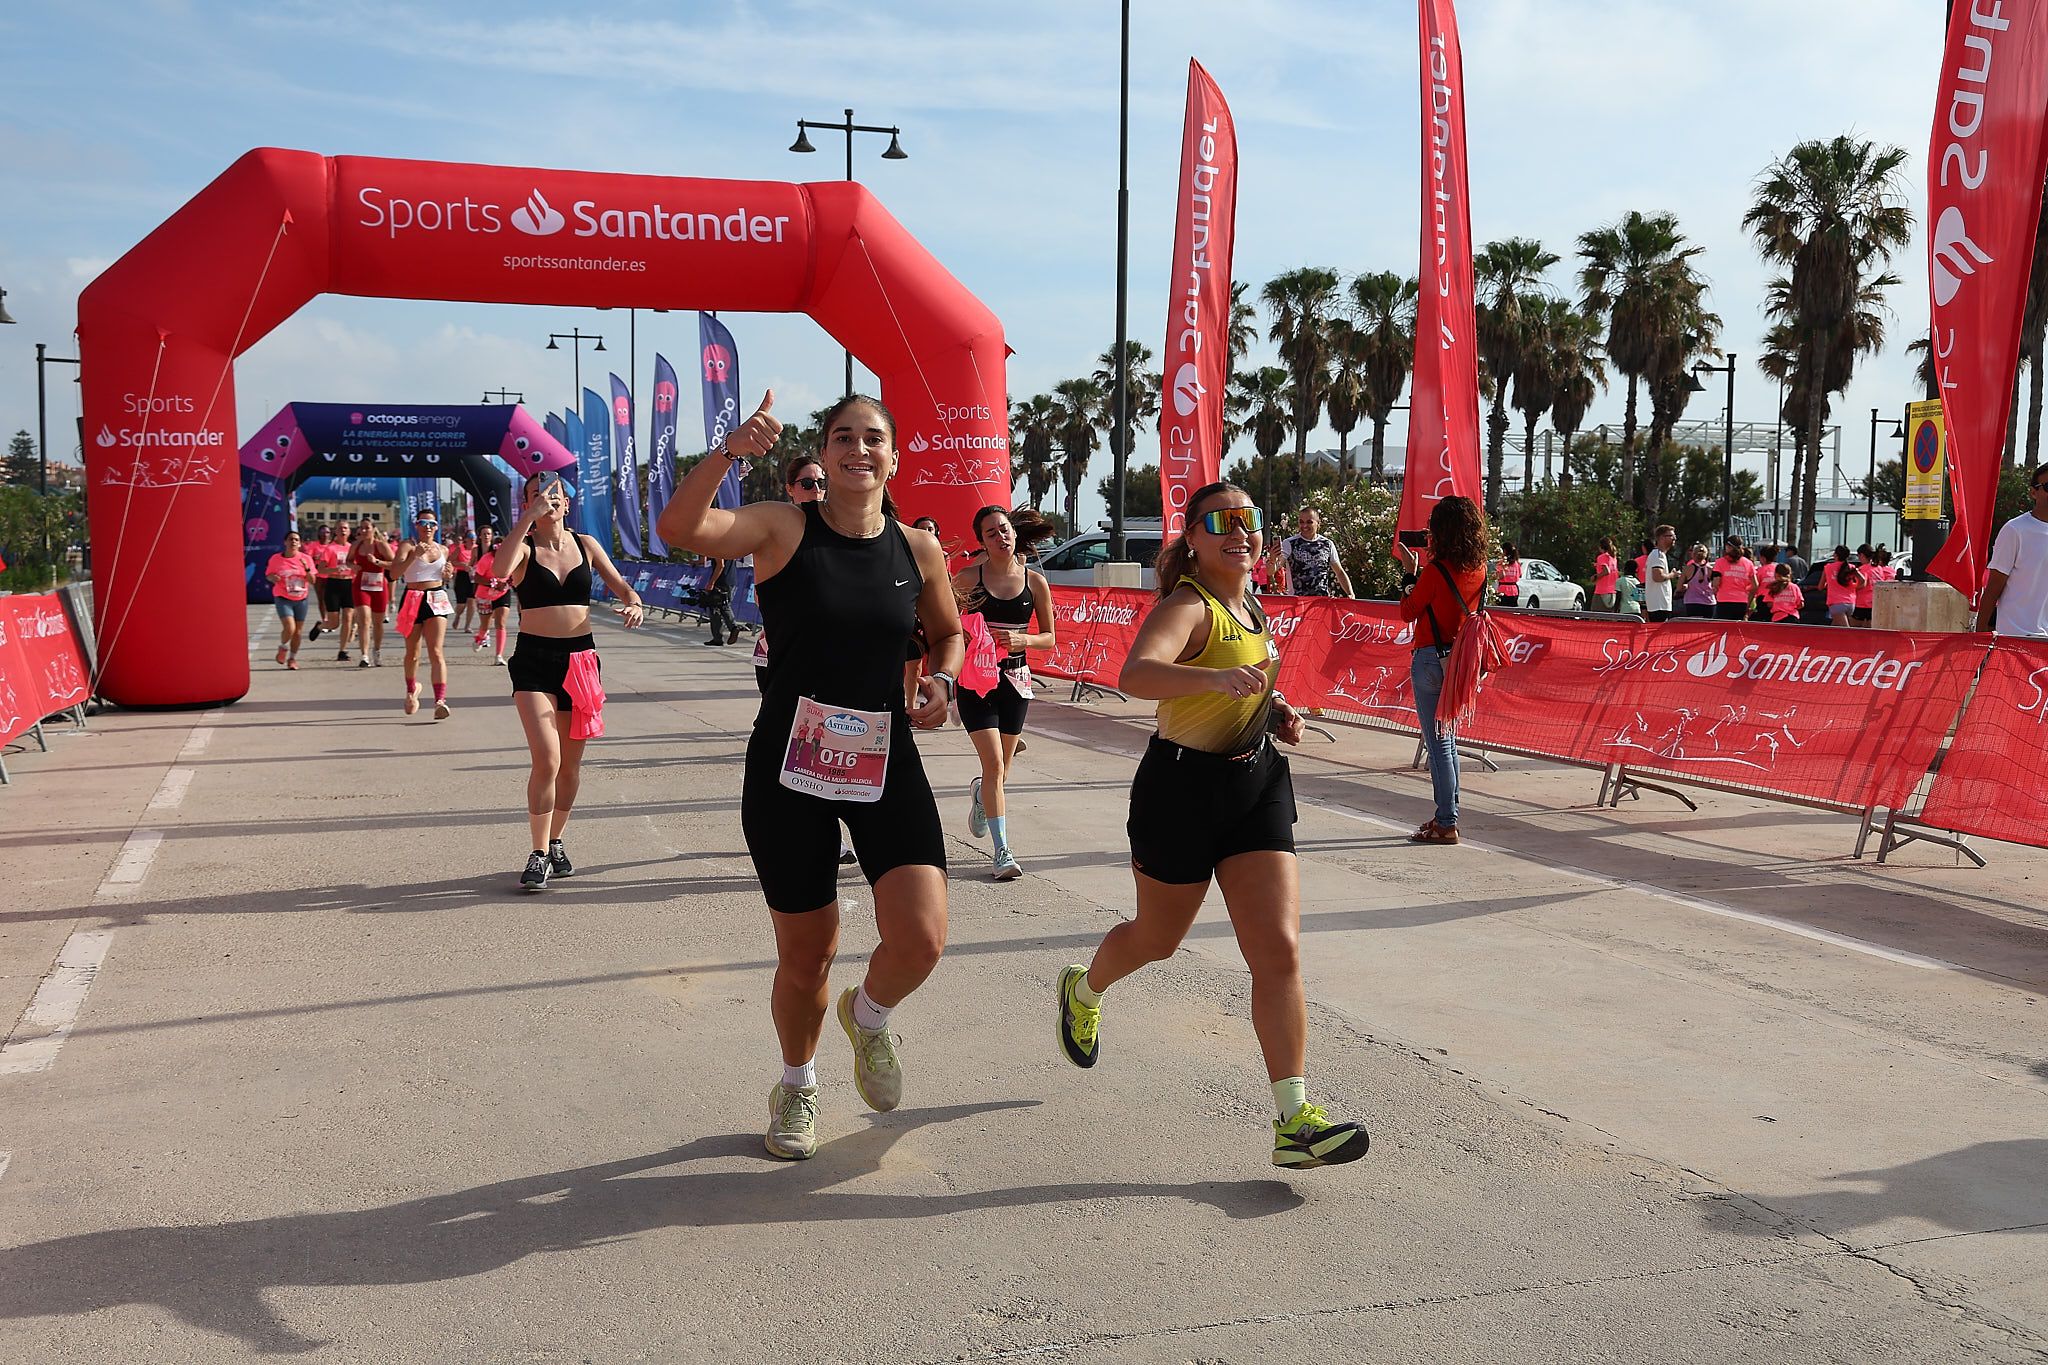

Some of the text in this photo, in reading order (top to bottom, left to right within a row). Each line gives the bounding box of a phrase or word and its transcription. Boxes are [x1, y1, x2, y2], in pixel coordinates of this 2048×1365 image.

[358, 187, 789, 243] Sports Santander
[503, 254, 646, 272] sportssantander.es
[123, 393, 195, 417] Sports
[936, 403, 990, 424] Sports
[120, 428, 225, 447] Santander
[357, 430, 397, 439] ENERGÍA
[400, 431, 425, 439] PARA
[427, 431, 466, 439] CORRER
[931, 434, 1006, 450] Santander
[449, 440, 467, 448] LUZ
[322, 453, 440, 463] VOLVO
[1086, 601, 1137, 625] Santander
[1329, 612, 1395, 643] Sports
[1593, 638, 1686, 678] Sports
[1727, 643, 1923, 691] Santander
[827, 719, 866, 734] ASTURIANA
[820, 748, 858, 768] 016
[793, 766, 816, 778] CARRERA
[791, 777, 824, 791] OYSHO
[841, 788, 871, 797] Santander
